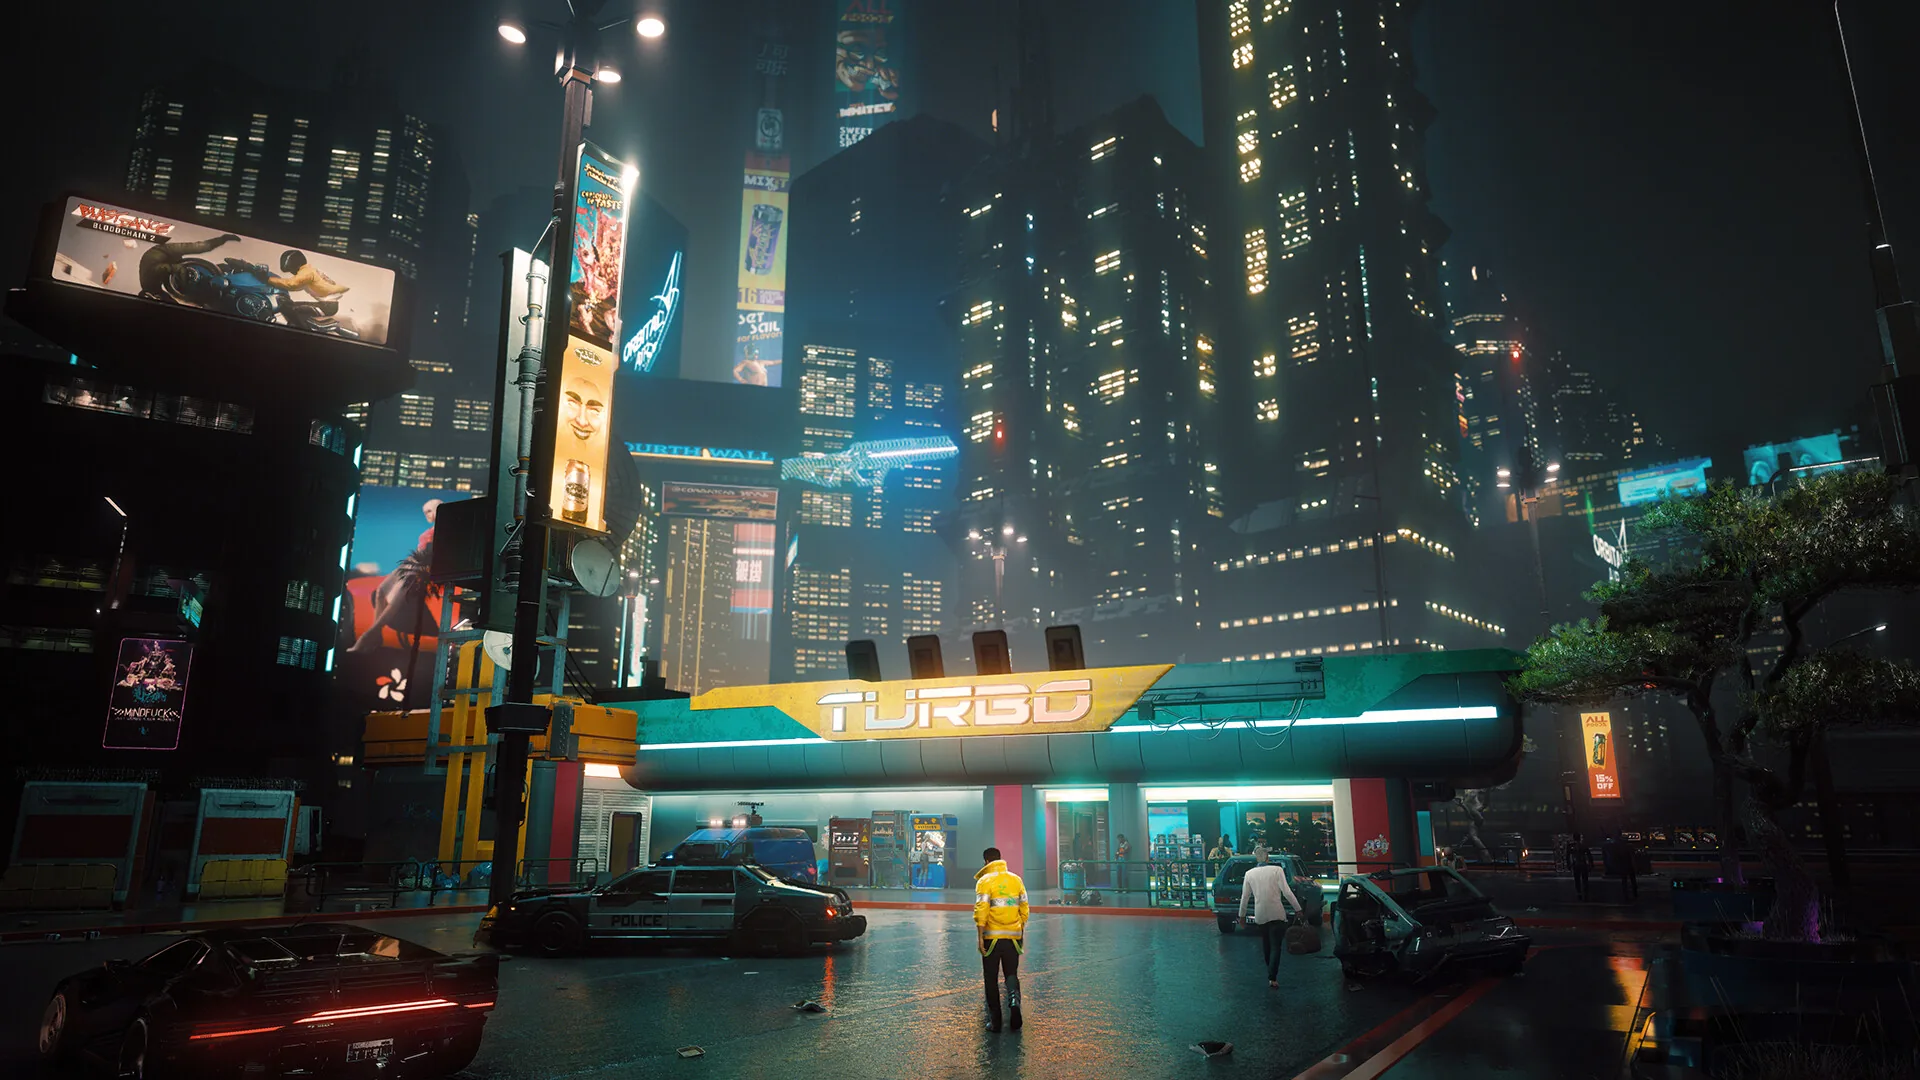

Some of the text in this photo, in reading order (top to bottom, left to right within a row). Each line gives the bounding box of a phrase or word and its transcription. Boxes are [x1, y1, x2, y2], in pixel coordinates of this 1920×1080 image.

[840, 126, 873, 135] SWEET
[595, 199, 623, 210] TASTE
[92, 222, 147, 240] BLOODCHAIN
[708, 447, 775, 462] WALL
[816, 679, 1093, 733] TURBO
[123, 706, 172, 719] MINDFUCK
[1586, 715, 1608, 723] ALL
[1595, 773, 1614, 784] 15%
[1596, 782, 1614, 790] OFF
[611, 914, 663, 927] POLICE
